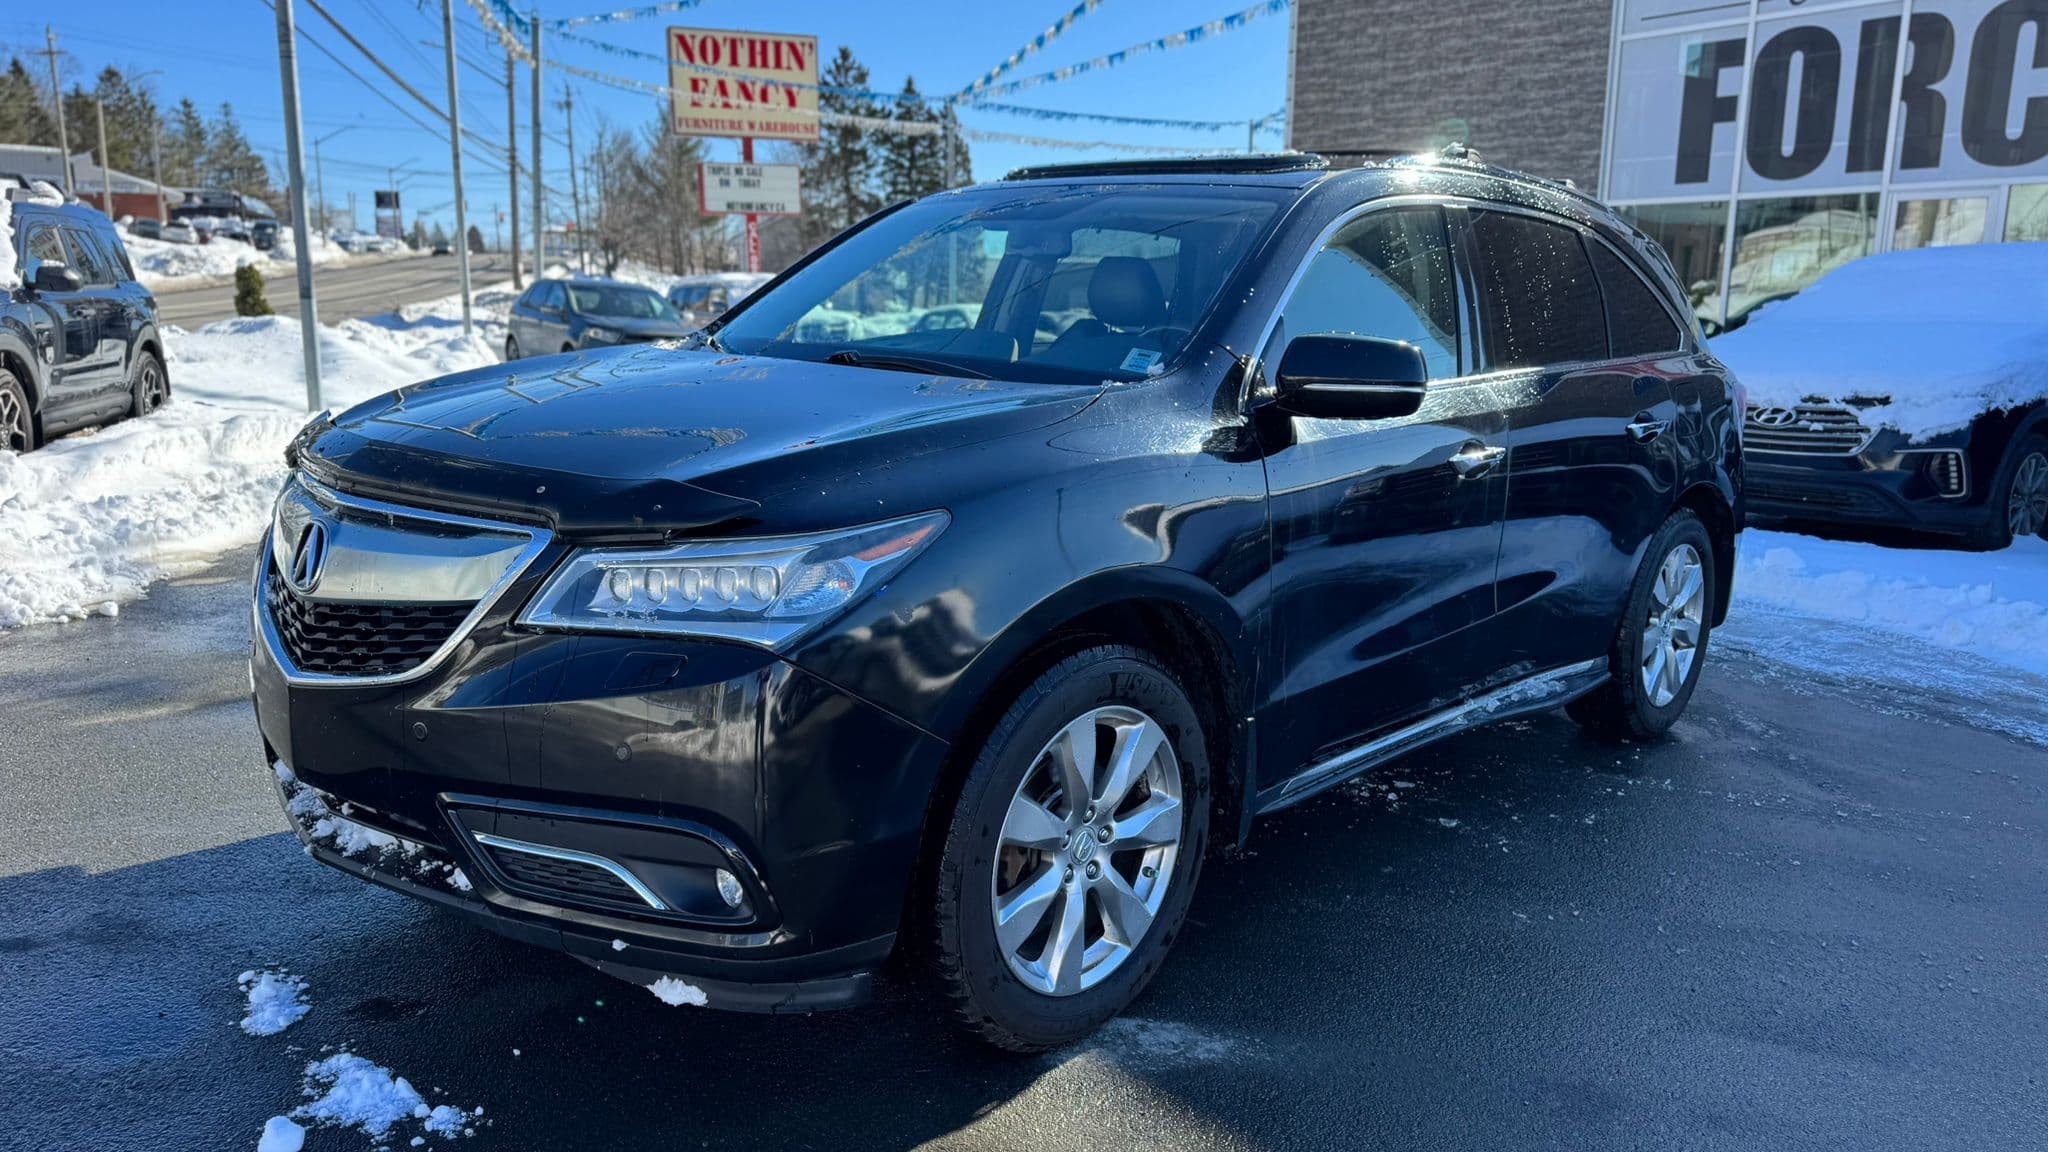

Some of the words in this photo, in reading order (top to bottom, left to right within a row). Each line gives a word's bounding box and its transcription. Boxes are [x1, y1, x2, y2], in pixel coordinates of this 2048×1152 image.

[673, 33, 814, 71] NOTHIN'
[689, 78, 800, 110] FANCY
[678, 117, 743, 131] FURNITURE
[747, 121, 816, 134] WAREHOUSE
